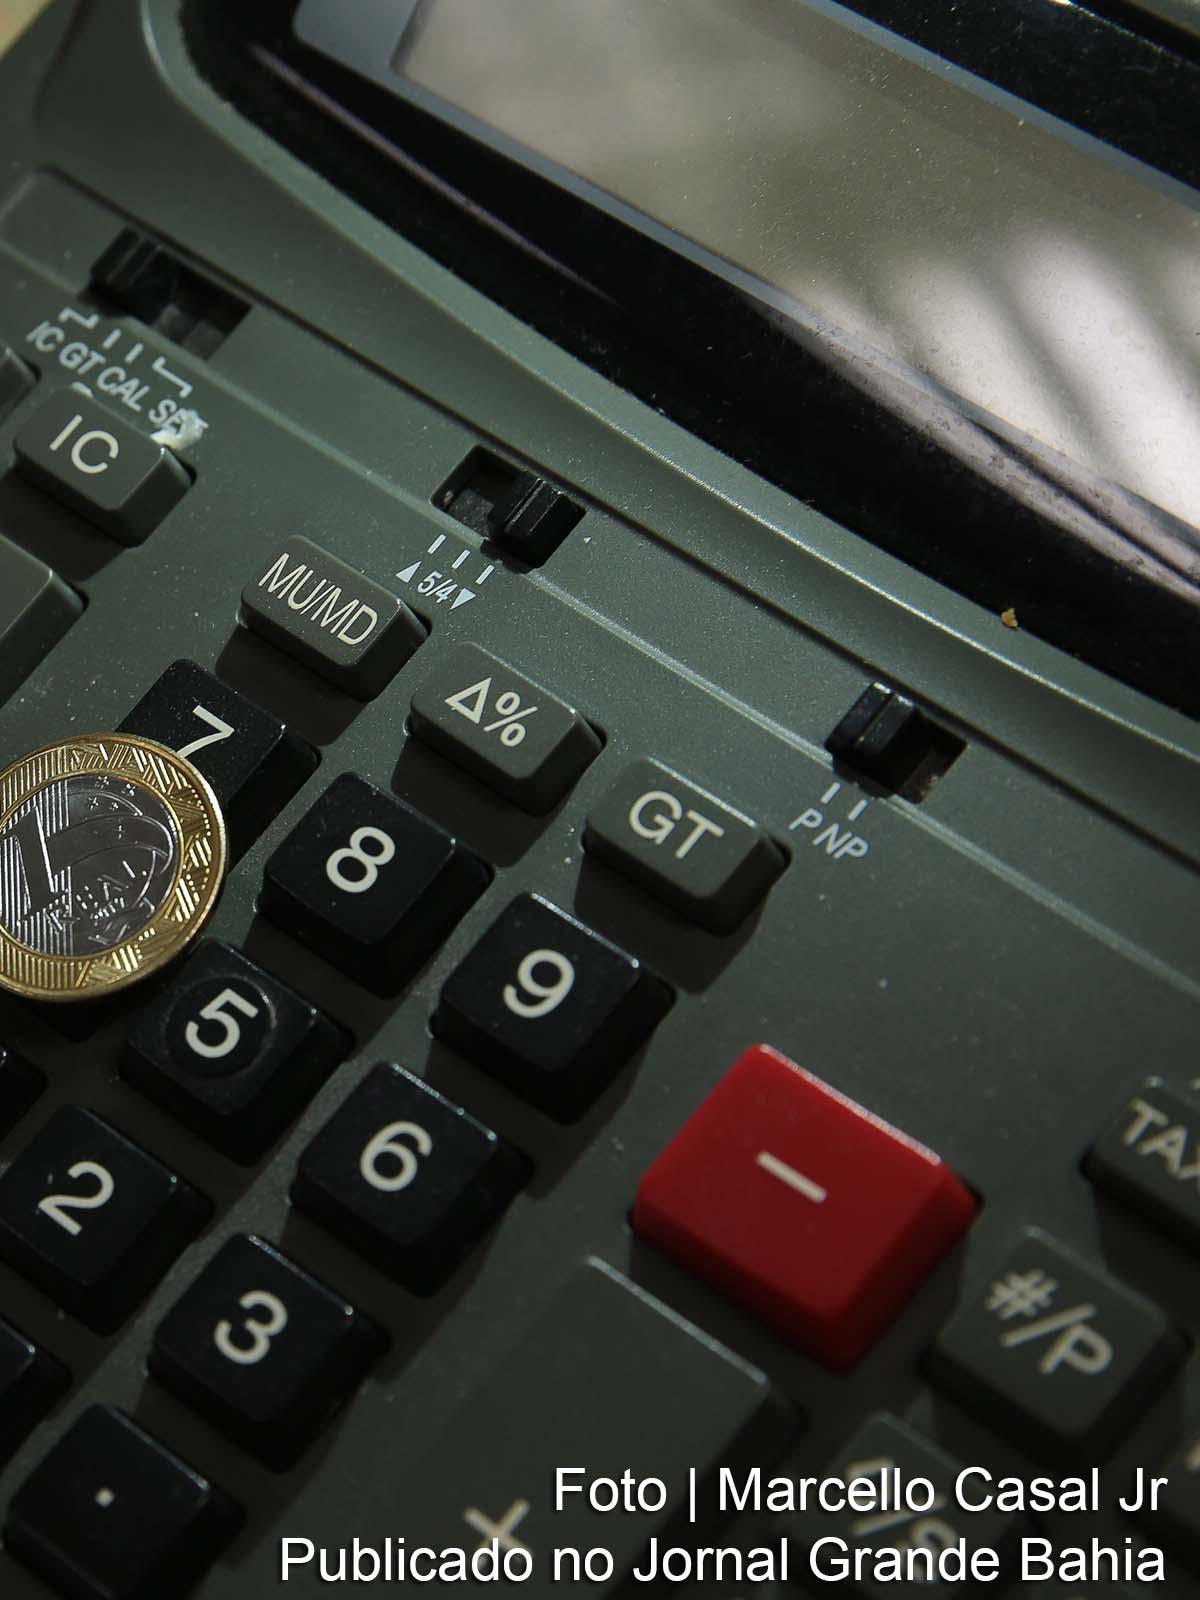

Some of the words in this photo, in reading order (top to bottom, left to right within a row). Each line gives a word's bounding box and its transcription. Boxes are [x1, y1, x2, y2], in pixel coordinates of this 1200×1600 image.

[25, 321, 65, 352] IC
[59, 341, 106, 375] GT
[97, 366, 150, 412] CAL
[49, 414, 120, 475] IC
[258, 552, 379, 647] MU/MD
[417, 570, 458, 604] 5/4
[176, 704, 236, 759] 7
[629, 789, 725, 860] GT
[788, 808, 824, 830] P
[325, 825, 397, 894] 8
[502, 948, 576, 1019] 9
[184, 988, 260, 1059] 5
[359, 1120, 433, 1193] 6
[37, 1160, 115, 1236] 2
[213, 1290, 288, 1365] 3
[986, 1269, 1114, 1376] #/P
